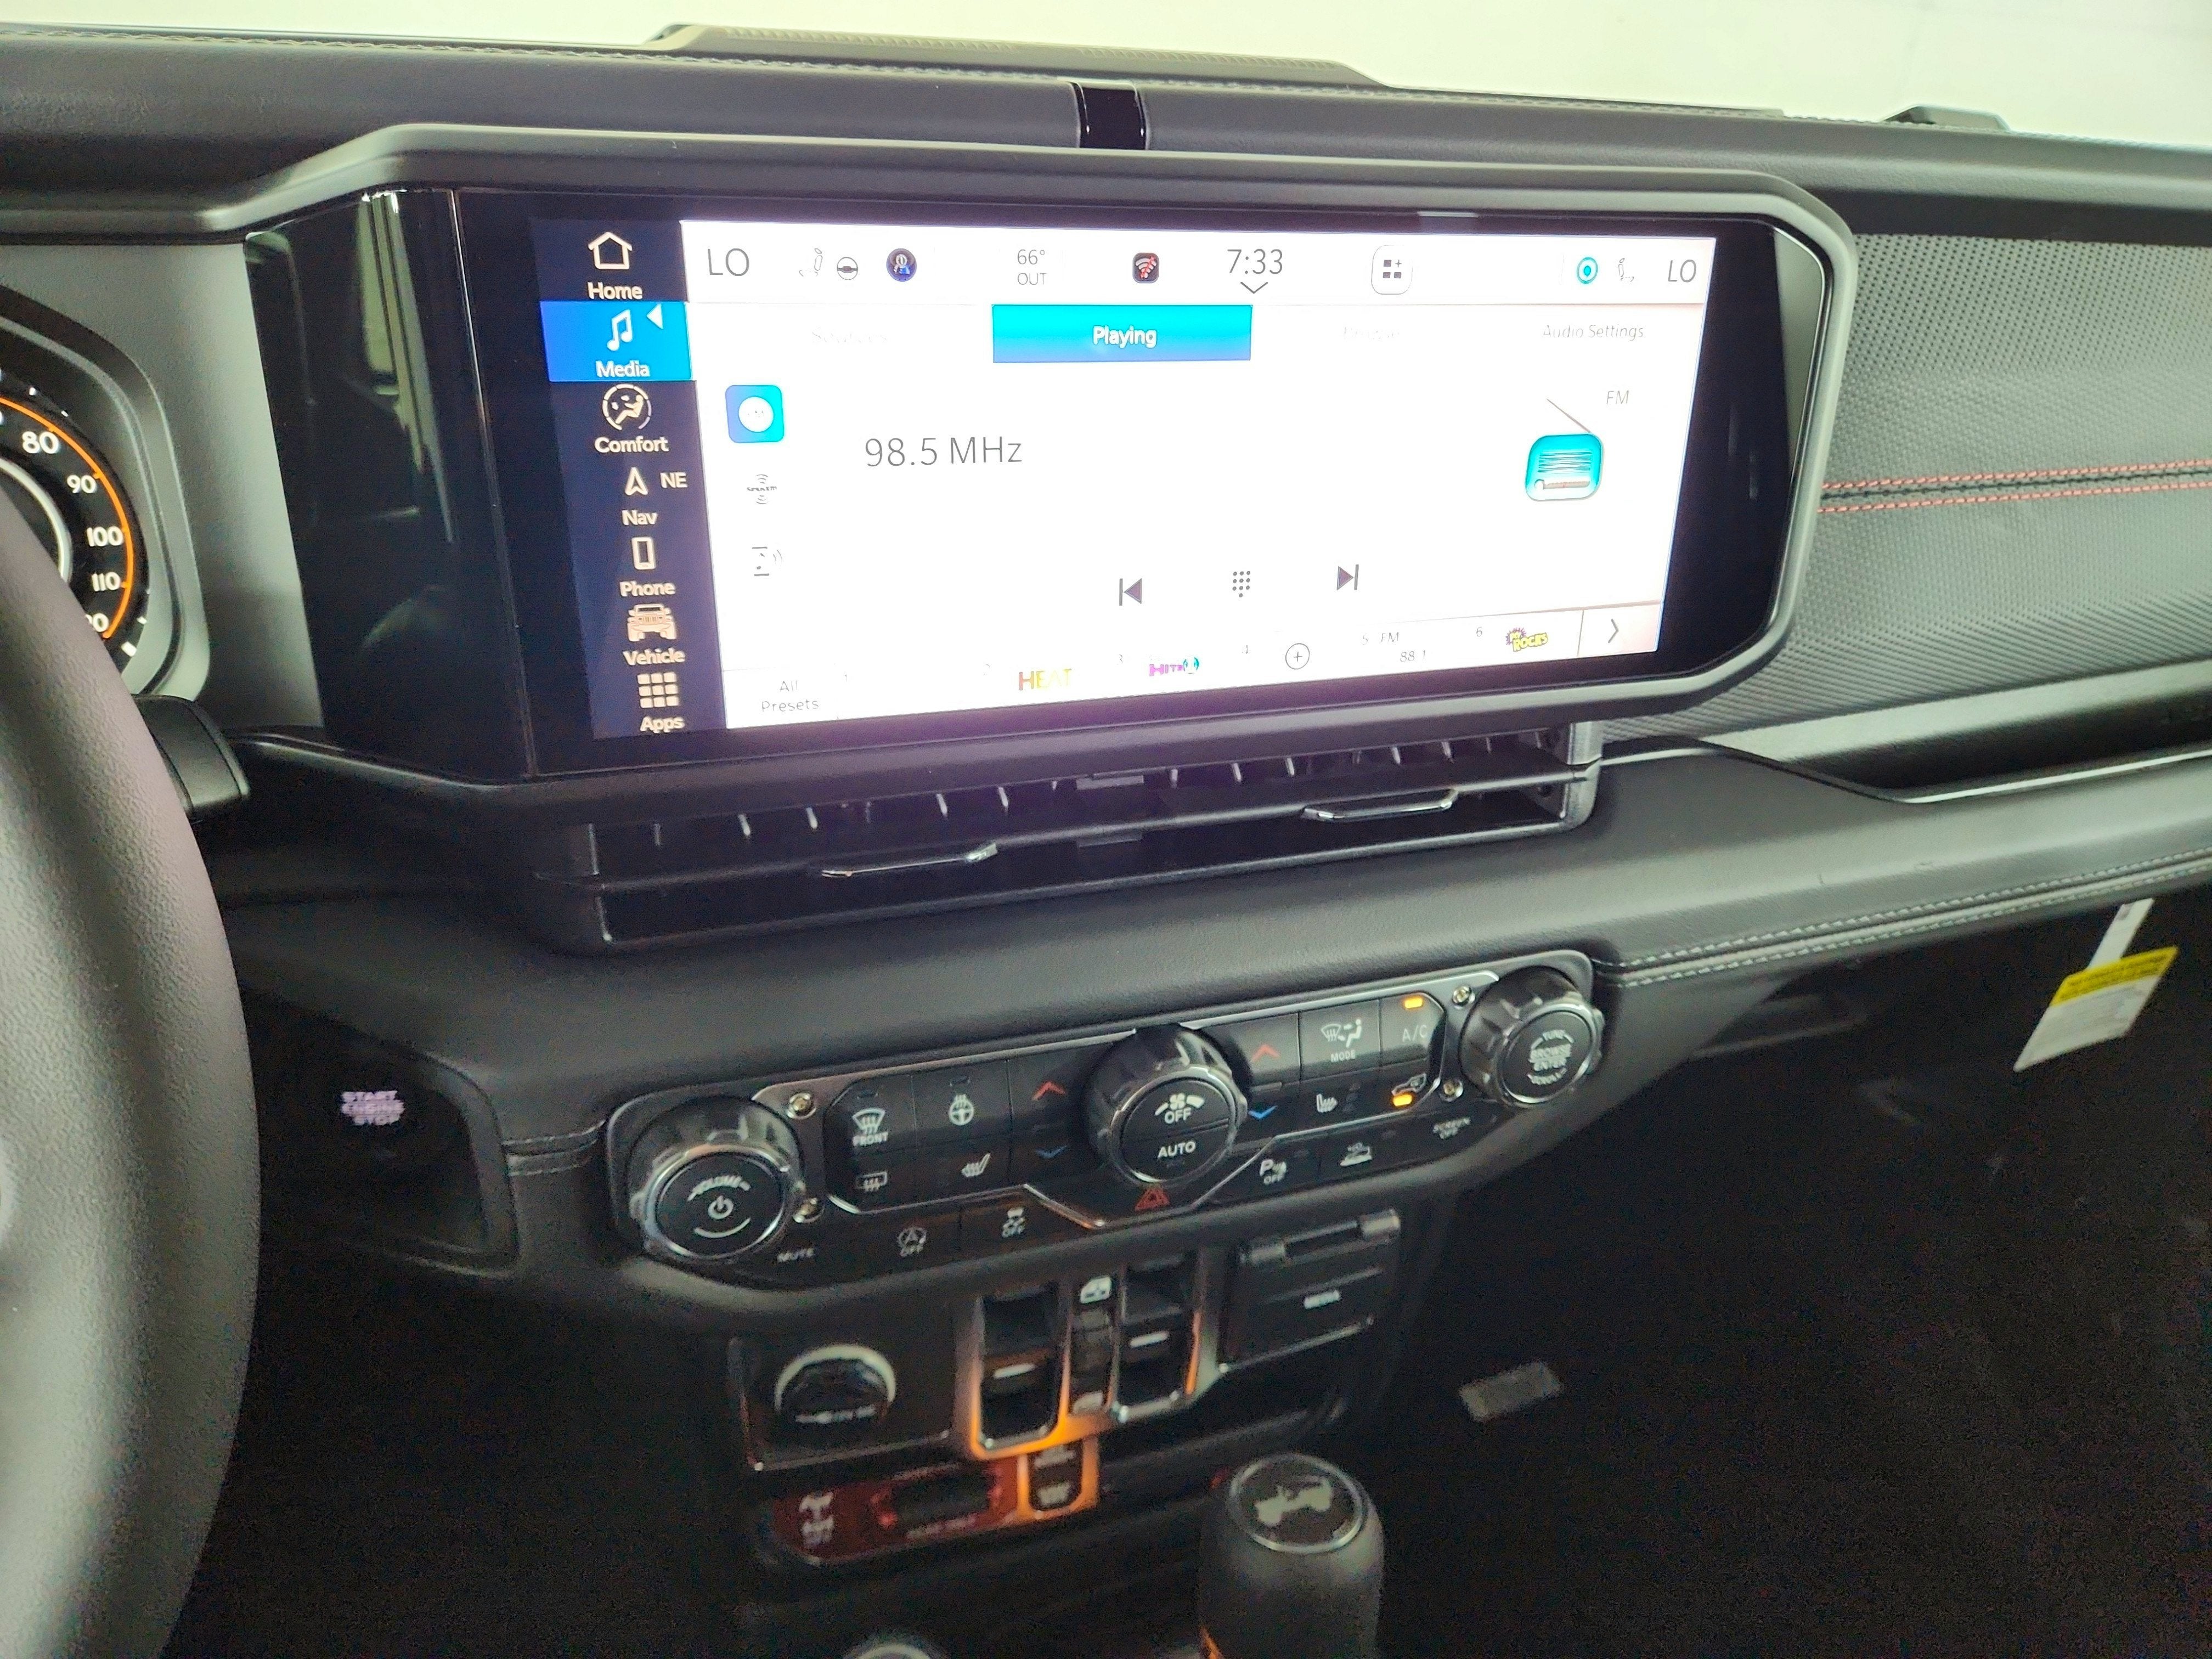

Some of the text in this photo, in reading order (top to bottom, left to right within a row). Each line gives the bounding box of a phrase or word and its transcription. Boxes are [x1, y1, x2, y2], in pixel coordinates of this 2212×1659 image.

[708, 249, 749, 276] LO
[1017, 249, 1046, 266] 66°
[1227, 249, 1283, 275] 7:33
[1017, 272, 1047, 285] OUT
[1667, 259, 1697, 283] LO
[587, 281, 643, 300] Home
[1092, 325, 1157, 348] Playing
[1542, 324, 1644, 341] Audio Settings
[595, 360, 651, 378] Media
[1605, 390, 1629, 405] FM
[22, 431, 60, 454] 80
[594, 436, 669, 453] Comfort
[865, 436, 1023, 467] 98.5 MHz
[66, 474, 97, 494] 90
[660, 472, 688, 488] NE
[622, 509, 658, 526] Nav
[86, 525, 124, 548] 100
[92, 571, 121, 591] 110
[619, 581, 676, 597] Phone
[86, 614, 110, 633] 0
[1476, 627, 1483, 637] 6
[1381, 632, 1399, 642] FM
[622, 647, 686, 666] Vehicle
[779, 679, 798, 692] All
[1018, 668, 1073, 691] HEAT
[761, 698, 820, 713] Presets
[640, 715, 685, 734] Apps
[1330, 1049, 1356, 1063] MODE
[1164, 1107, 1192, 1124] OFF
[852, 1131, 889, 1147] FRONT
[1157, 1141, 1197, 1159] AUTO
